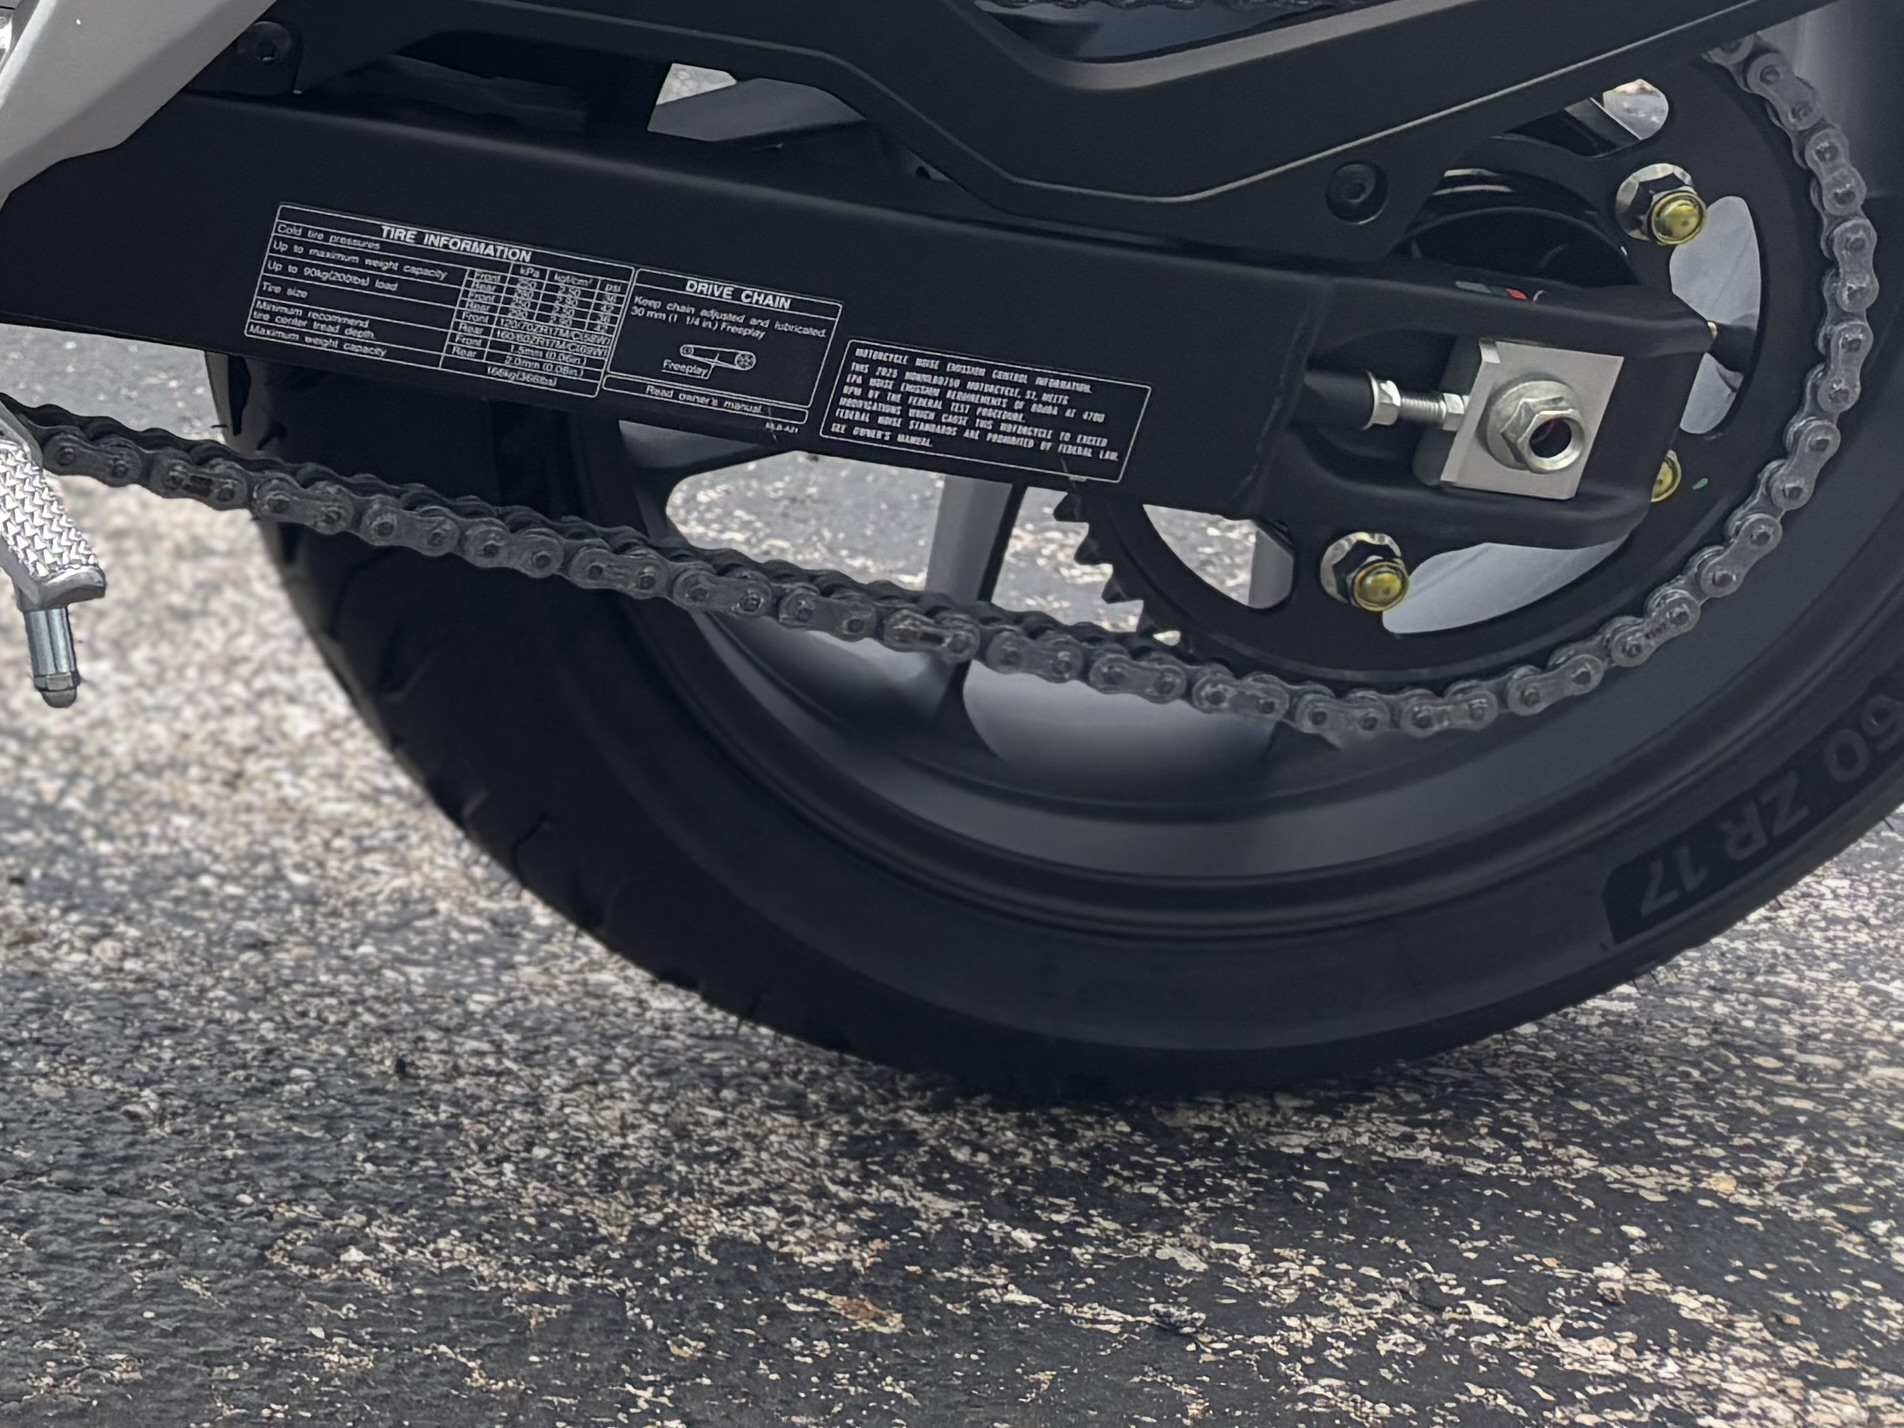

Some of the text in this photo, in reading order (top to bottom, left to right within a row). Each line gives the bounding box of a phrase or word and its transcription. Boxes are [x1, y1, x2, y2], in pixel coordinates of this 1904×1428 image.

[276, 222, 303, 237] Cold
[327, 233, 381, 250] pressures
[380, 224, 532, 262] TIRE INFORMATION
[266, 258, 283, 273] Up
[286, 263, 299, 274] to
[373, 278, 399, 292] load
[271, 238, 448, 281] Up to maximum weight capacity
[261, 280, 308, 299] Tire size
[684, 279, 792, 310] DRIVE CHAIN
[629, 304, 646, 317] 30
[645, 309, 667, 321] mm
[719, 320, 766, 340] Freeplay
[632, 294, 826, 338] Keep chain adjusted and lubricated.
[450, 344, 477, 358] Rear
[661, 358, 708, 376] Freeplay
[644, 383, 674, 399] Read
[1716, 770, 1811, 862] ZR
[1640, 844, 1710, 919] 17
